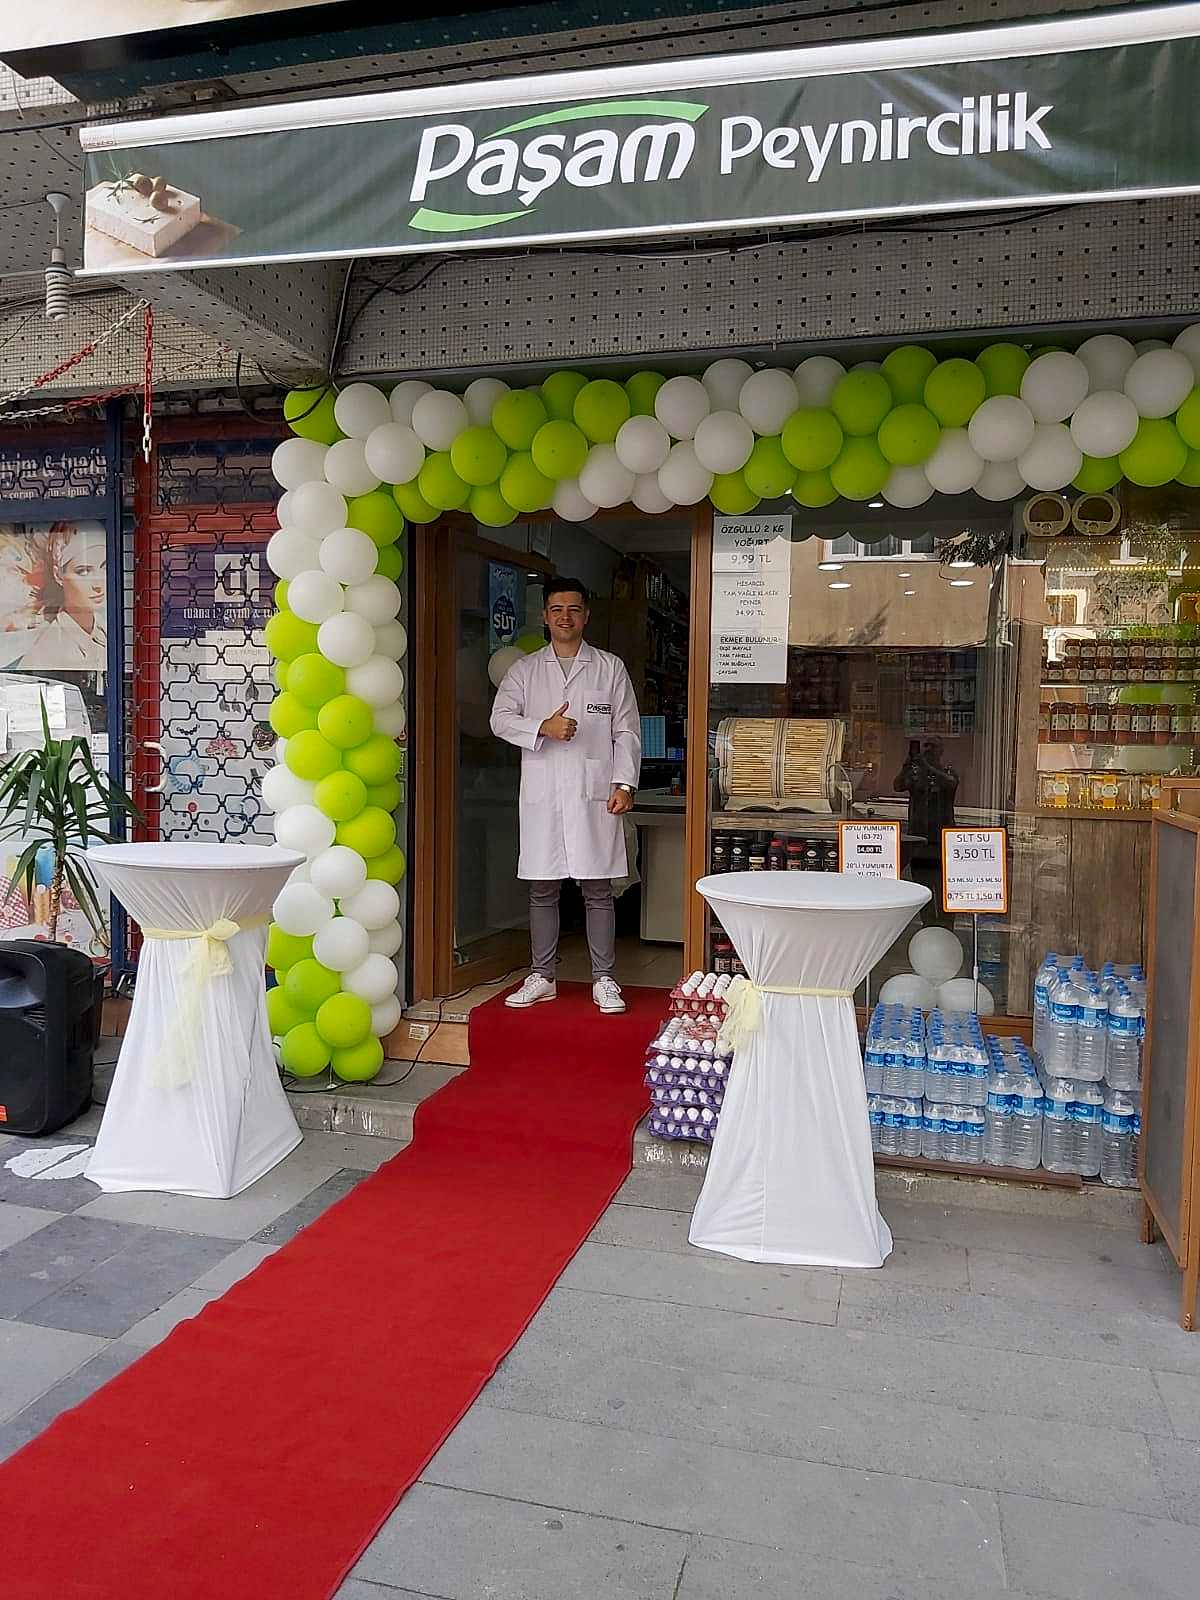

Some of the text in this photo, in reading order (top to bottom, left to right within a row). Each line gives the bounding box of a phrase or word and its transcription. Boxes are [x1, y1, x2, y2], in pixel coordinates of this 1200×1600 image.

[409, 92, 1054, 206] Paşam Peynircilik
[764, 524, 769, 533] 2
[773, 524, 784, 533] KG
[734, 537, 769, 547] YOĞURT
[759, 554, 772, 563] TL
[494, 611, 516, 631] SÜT
[720, 635, 743, 643] EKMEK
[976, 833, 990, 842] SU
[953, 848, 995, 860] 3,50 TL
